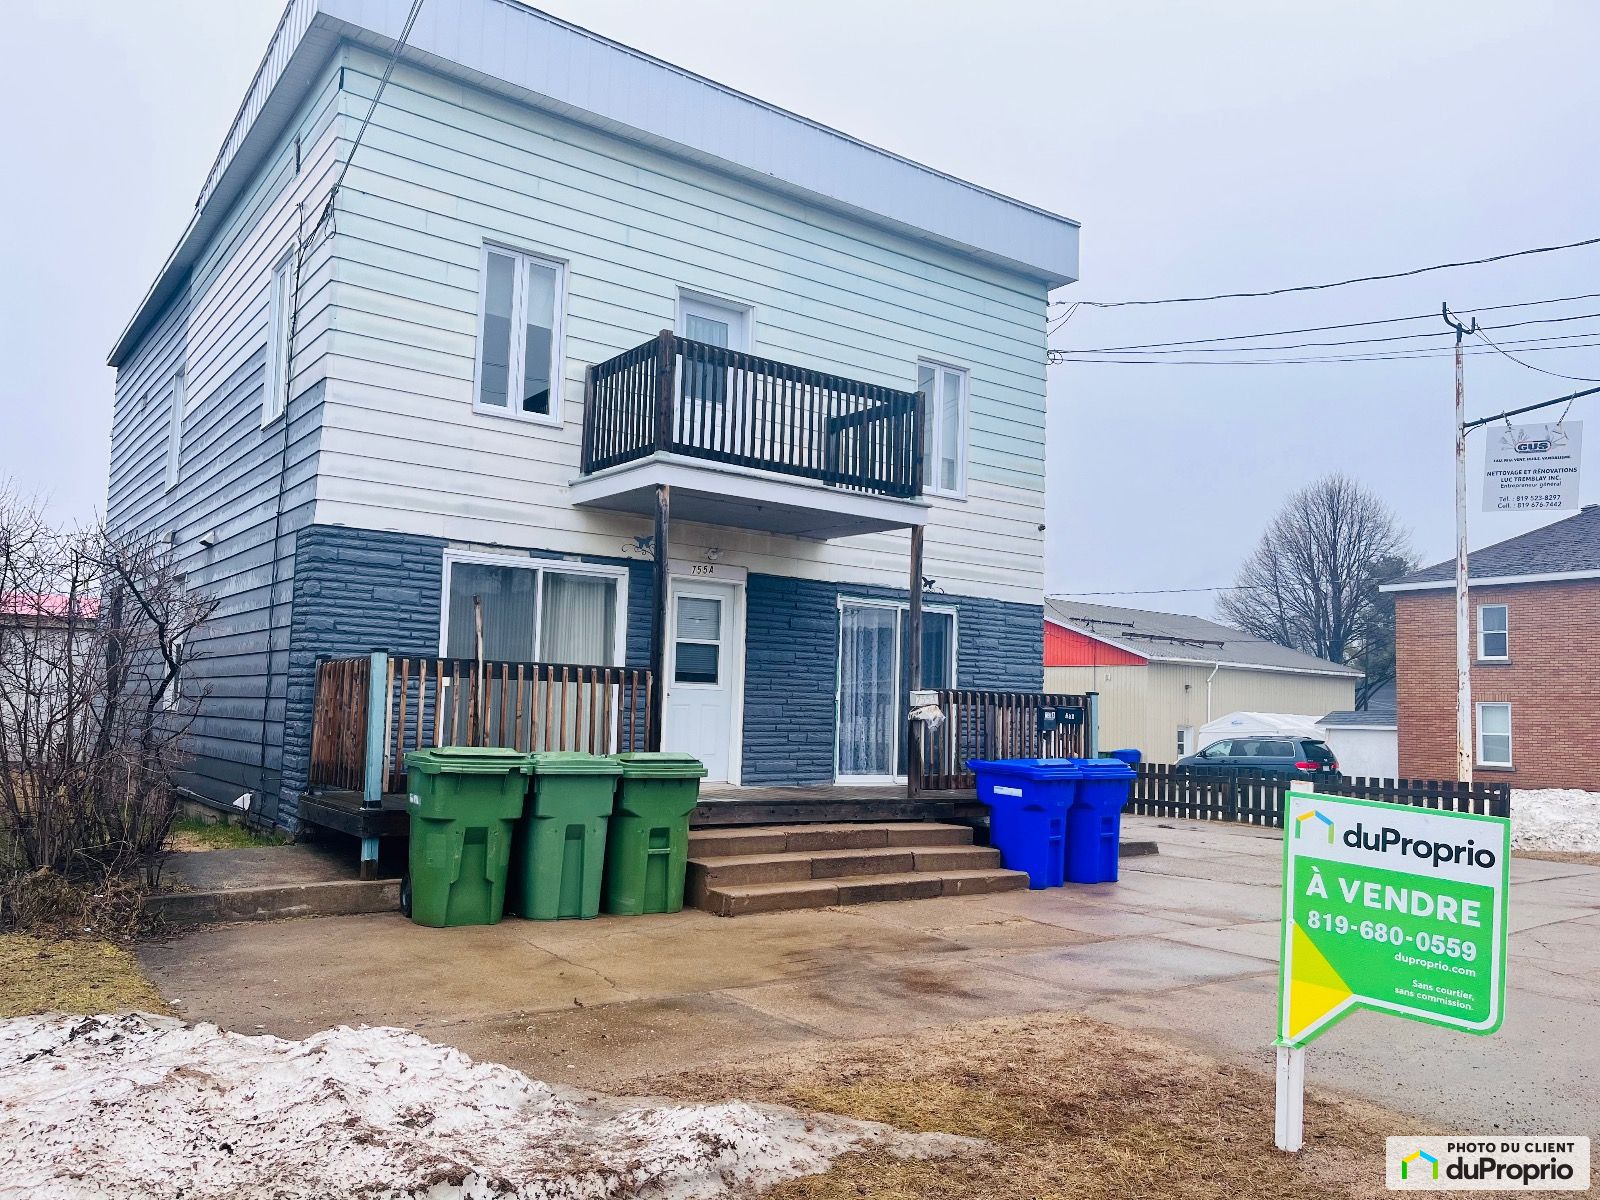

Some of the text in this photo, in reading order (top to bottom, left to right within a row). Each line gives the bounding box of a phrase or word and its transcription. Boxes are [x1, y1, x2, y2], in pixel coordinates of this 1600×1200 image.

[1517, 442, 1549, 451] GUS
[1486, 469, 1523, 477] NETTOYAGE
[692, 565, 714, 575] 755A
[1343, 823, 1496, 868] duProprio
[1305, 865, 1481, 928] À VENDRE
[1307, 910, 1477, 962] 819-680-0559
[1394, 952, 1476, 978] duproprio.com
[1394, 987, 1474, 1011] sans commission.
[1412, 979, 1475, 1002] Sans courtier,
